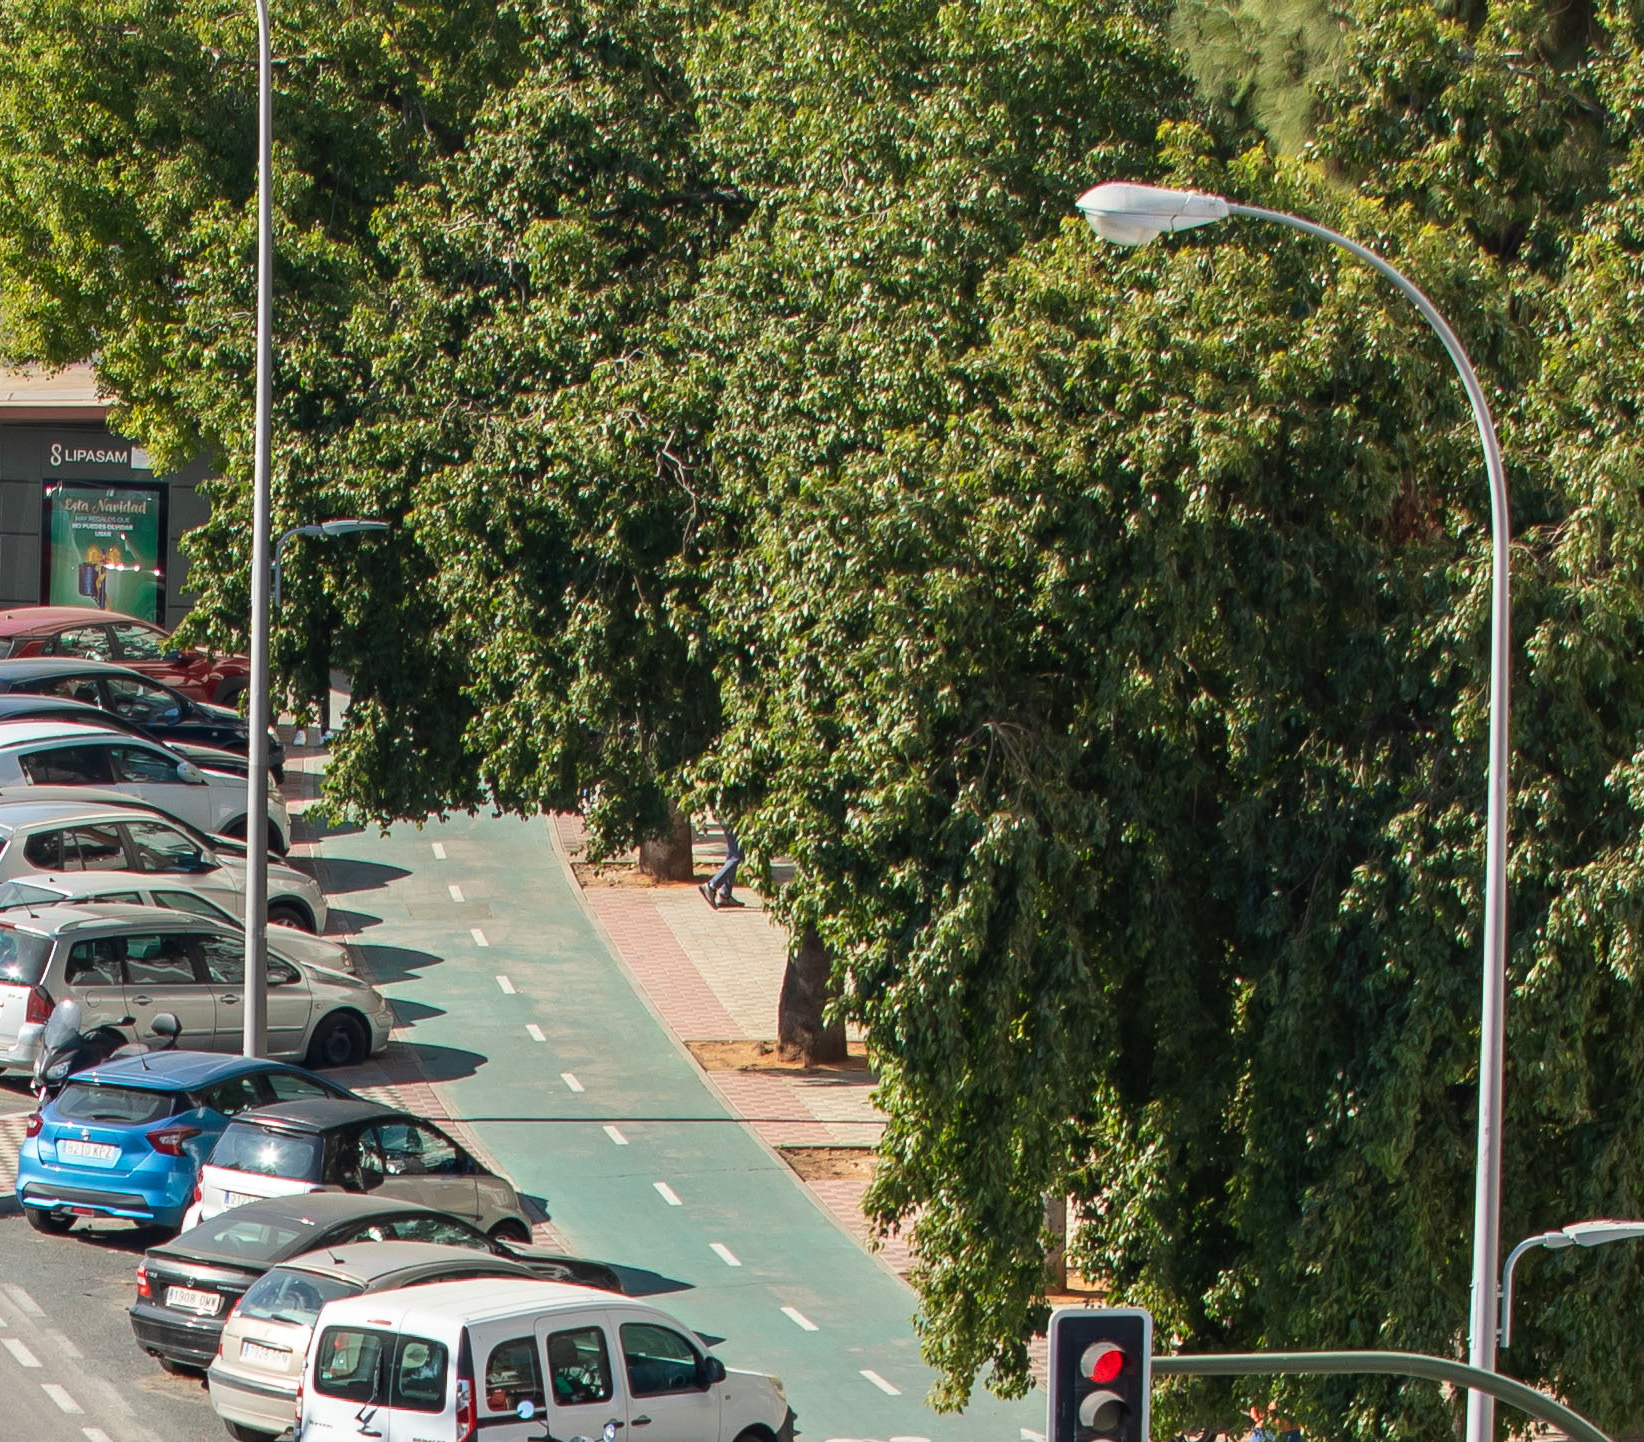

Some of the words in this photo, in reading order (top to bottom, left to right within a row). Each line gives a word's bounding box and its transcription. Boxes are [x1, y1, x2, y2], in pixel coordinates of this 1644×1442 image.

[65, 450, 127, 463] LIPASAM
[64, 497, 89, 513] Esta
[92, 499, 147, 514] Navidad
